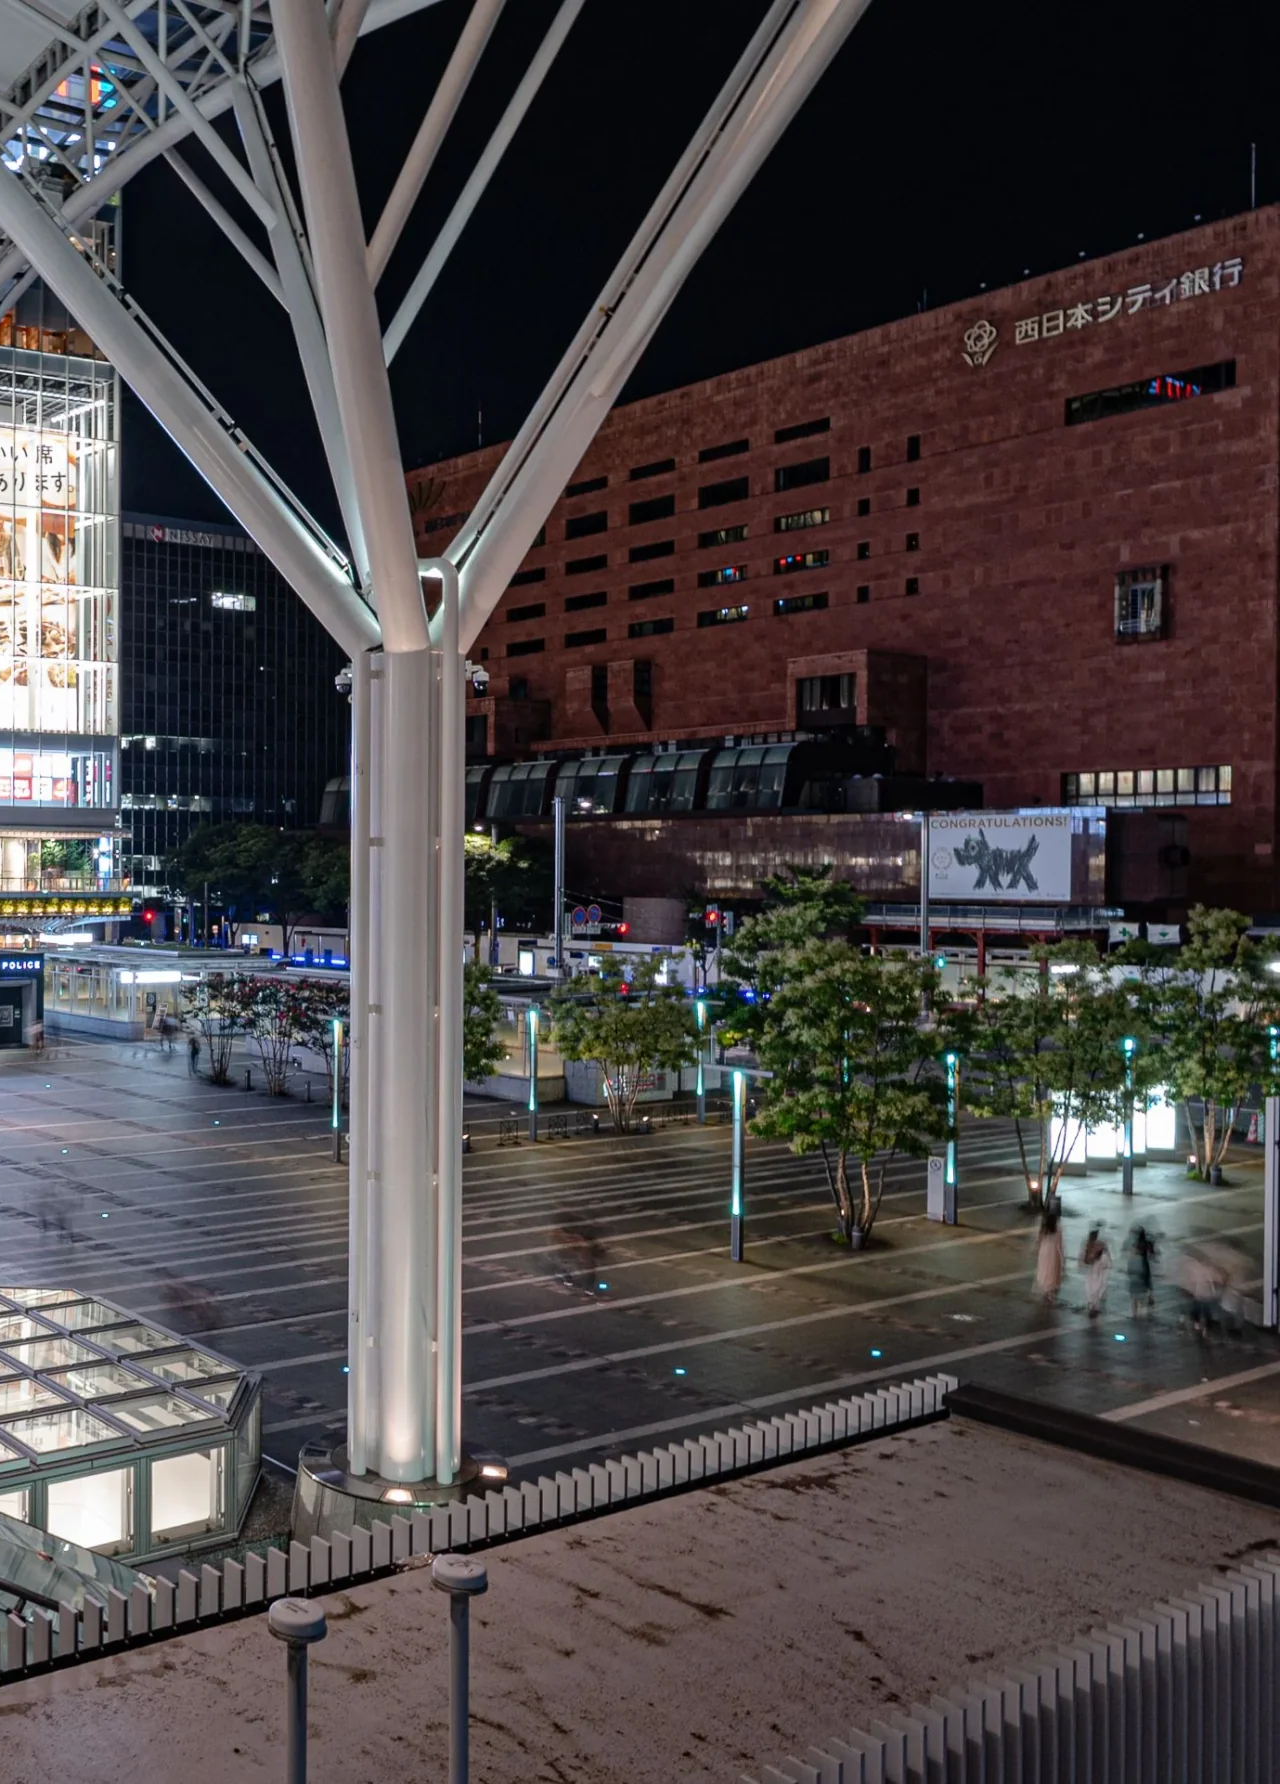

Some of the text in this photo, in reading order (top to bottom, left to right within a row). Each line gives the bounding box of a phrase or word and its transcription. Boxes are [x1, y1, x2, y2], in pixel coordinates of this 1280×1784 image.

[1014, 257, 1243, 345] 西日本シティ銀行
[170, 530, 212, 545] NISSAY
[931, 816, 1068, 830] CONGRATULATIONS!
[2, 961, 40, 969] POLICE
